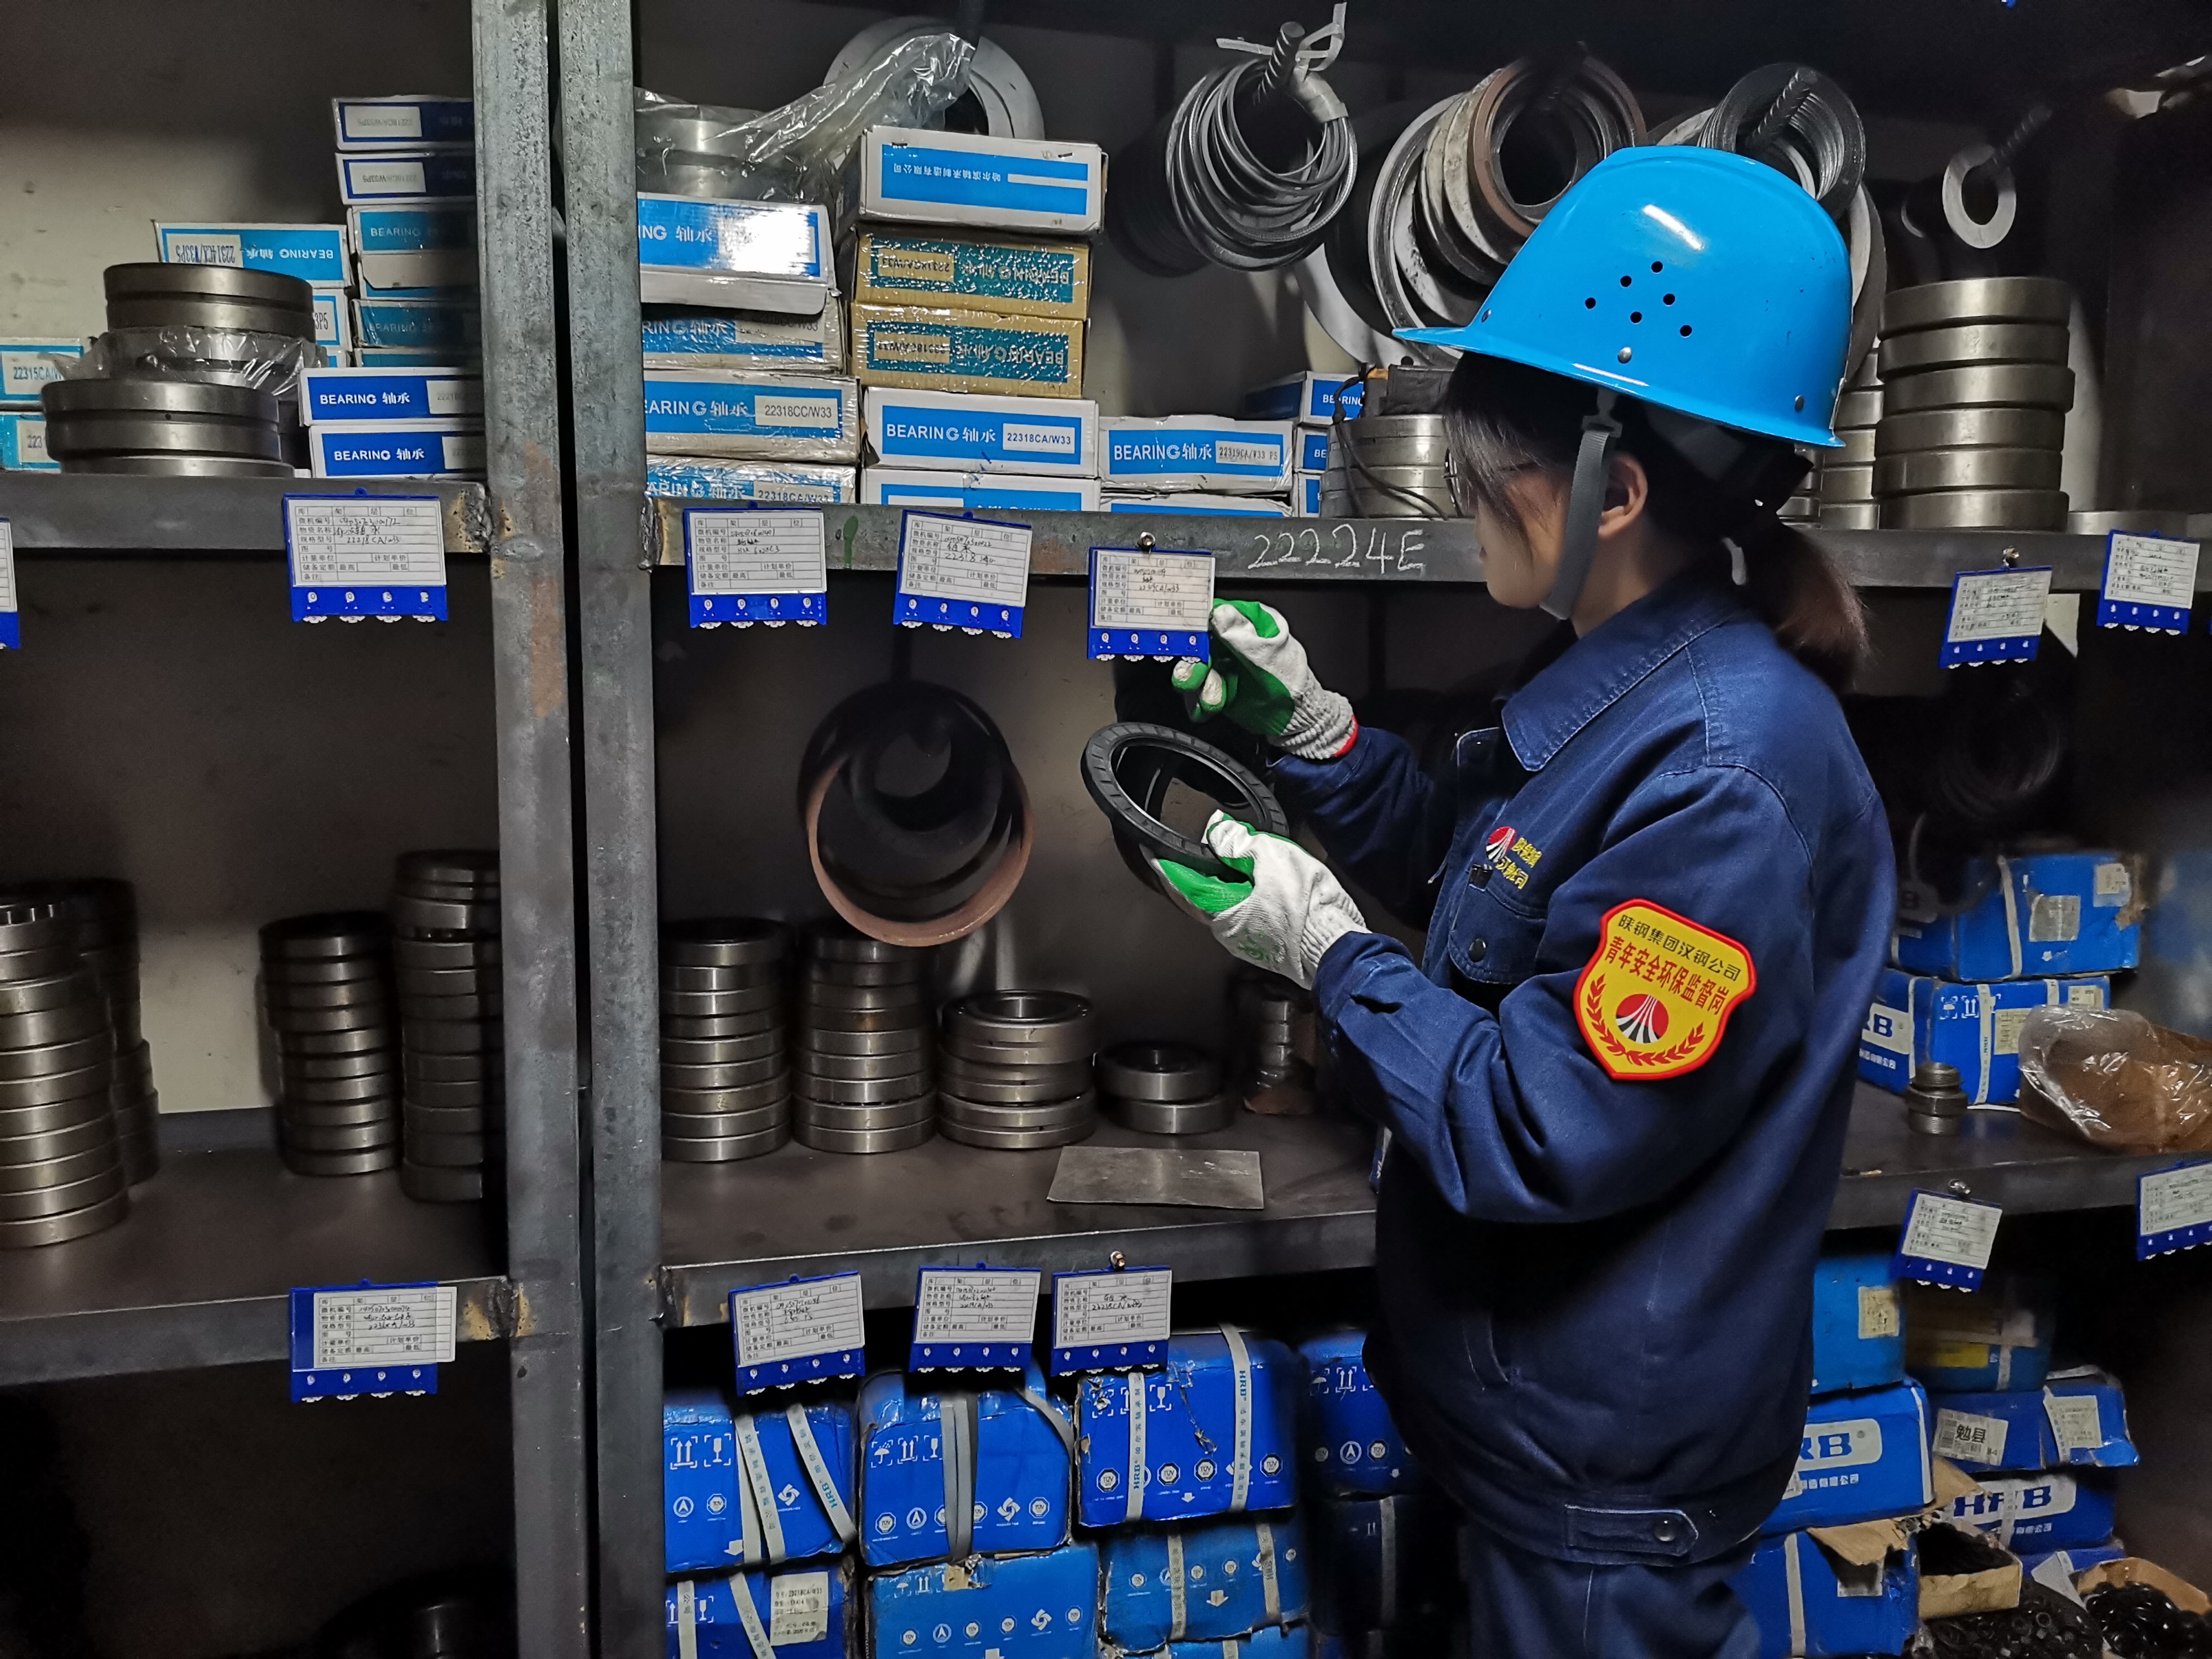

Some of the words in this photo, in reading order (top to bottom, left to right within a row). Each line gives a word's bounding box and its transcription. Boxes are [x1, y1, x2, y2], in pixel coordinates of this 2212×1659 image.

[893, 163, 1001, 182] 哈尔滨轴承制造有限公司
[675, 225, 713, 242] 轴承
[246, 248, 274, 260] 轴承
[279, 248, 334, 259] BEARING
[320, 394, 377, 404] BEARING
[382, 392, 410, 404] 轴承
[710, 400, 748, 417] 轴承
[765, 405, 832, 419] 22318CC/W33
[886, 424, 959, 441] BEARING
[962, 426, 996, 443] 轴承
[1007, 432, 1071, 445] 22318CA/W33
[333, 450, 391, 461] BEARING
[396, 448, 425, 460] 轴承
[1114, 445, 1181, 460] BEARING
[1182, 442, 1212, 460] 轴承
[1219, 446, 1265, 460] 22319CA/W33
[1248, 523, 1426, 575] 22224E
[1618, 914, 1741, 982] 陕钢集团汉钢公司
[1604, 935, 1729, 1015] 青年安全环保监督岗
[1956, 1423, 1986, 1444] 勉县
